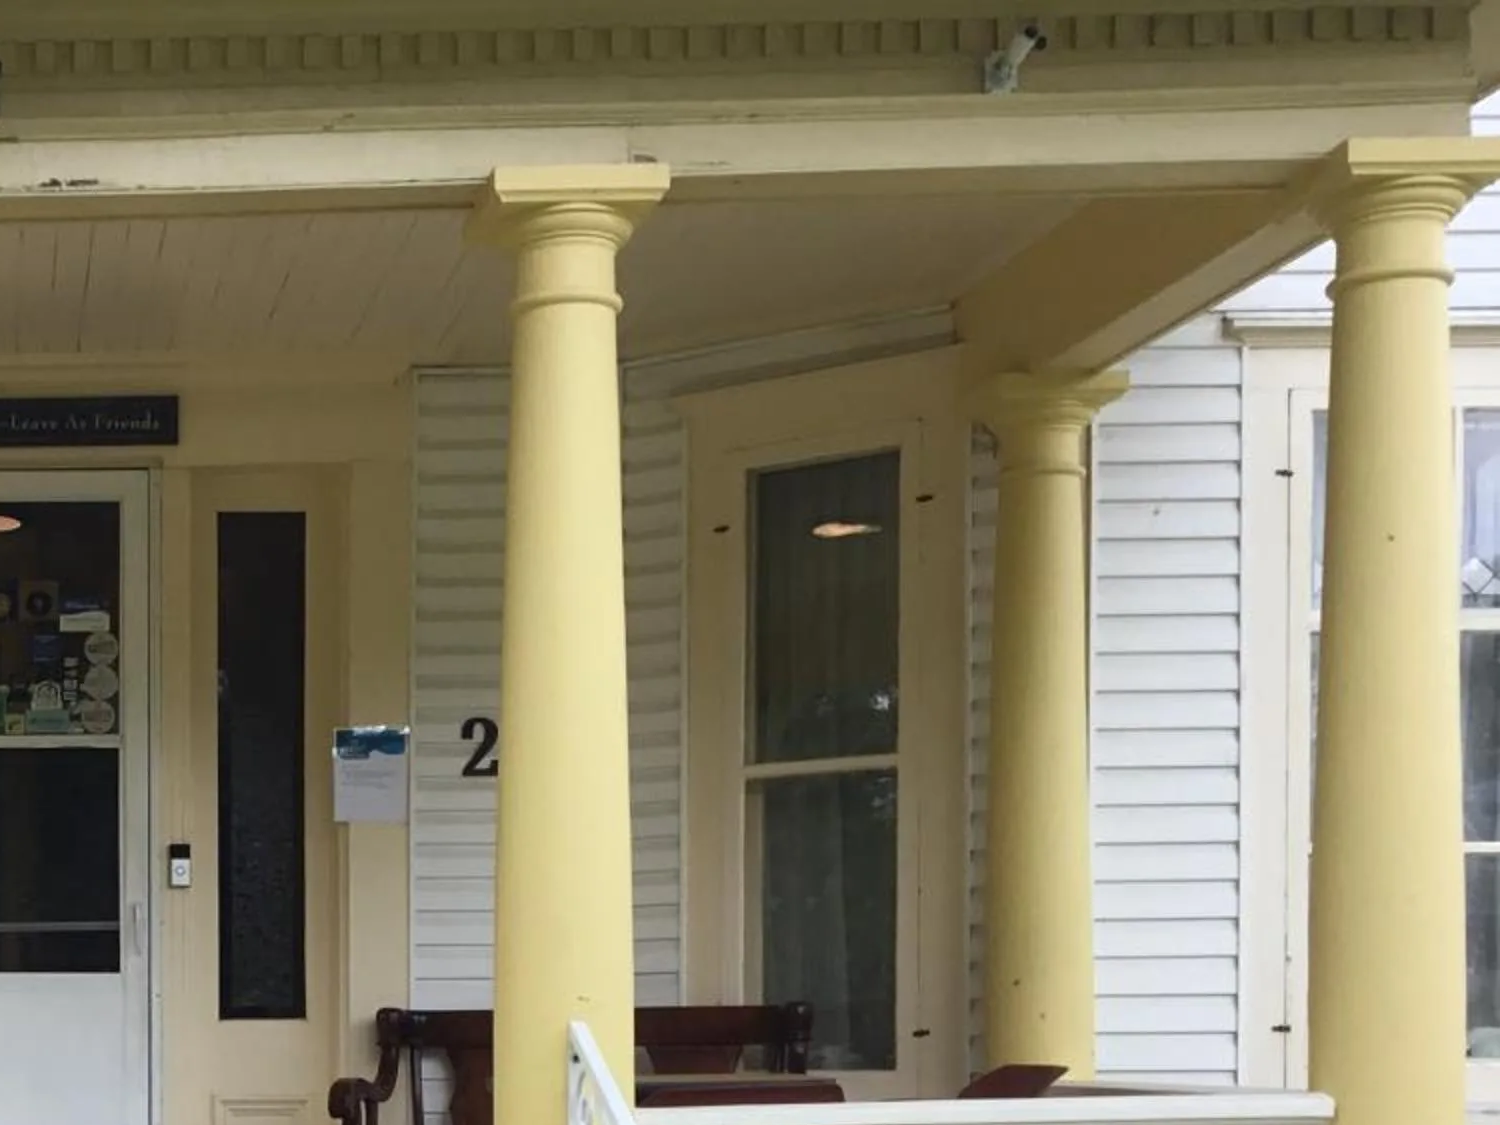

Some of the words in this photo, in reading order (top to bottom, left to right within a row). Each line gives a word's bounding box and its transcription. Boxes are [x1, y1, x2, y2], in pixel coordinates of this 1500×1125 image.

[11, 412, 58, 432] Leave
[65, 412, 87, 431] As
[95, 409, 160, 431] Friends
[461, 717, 499, 777] 2
